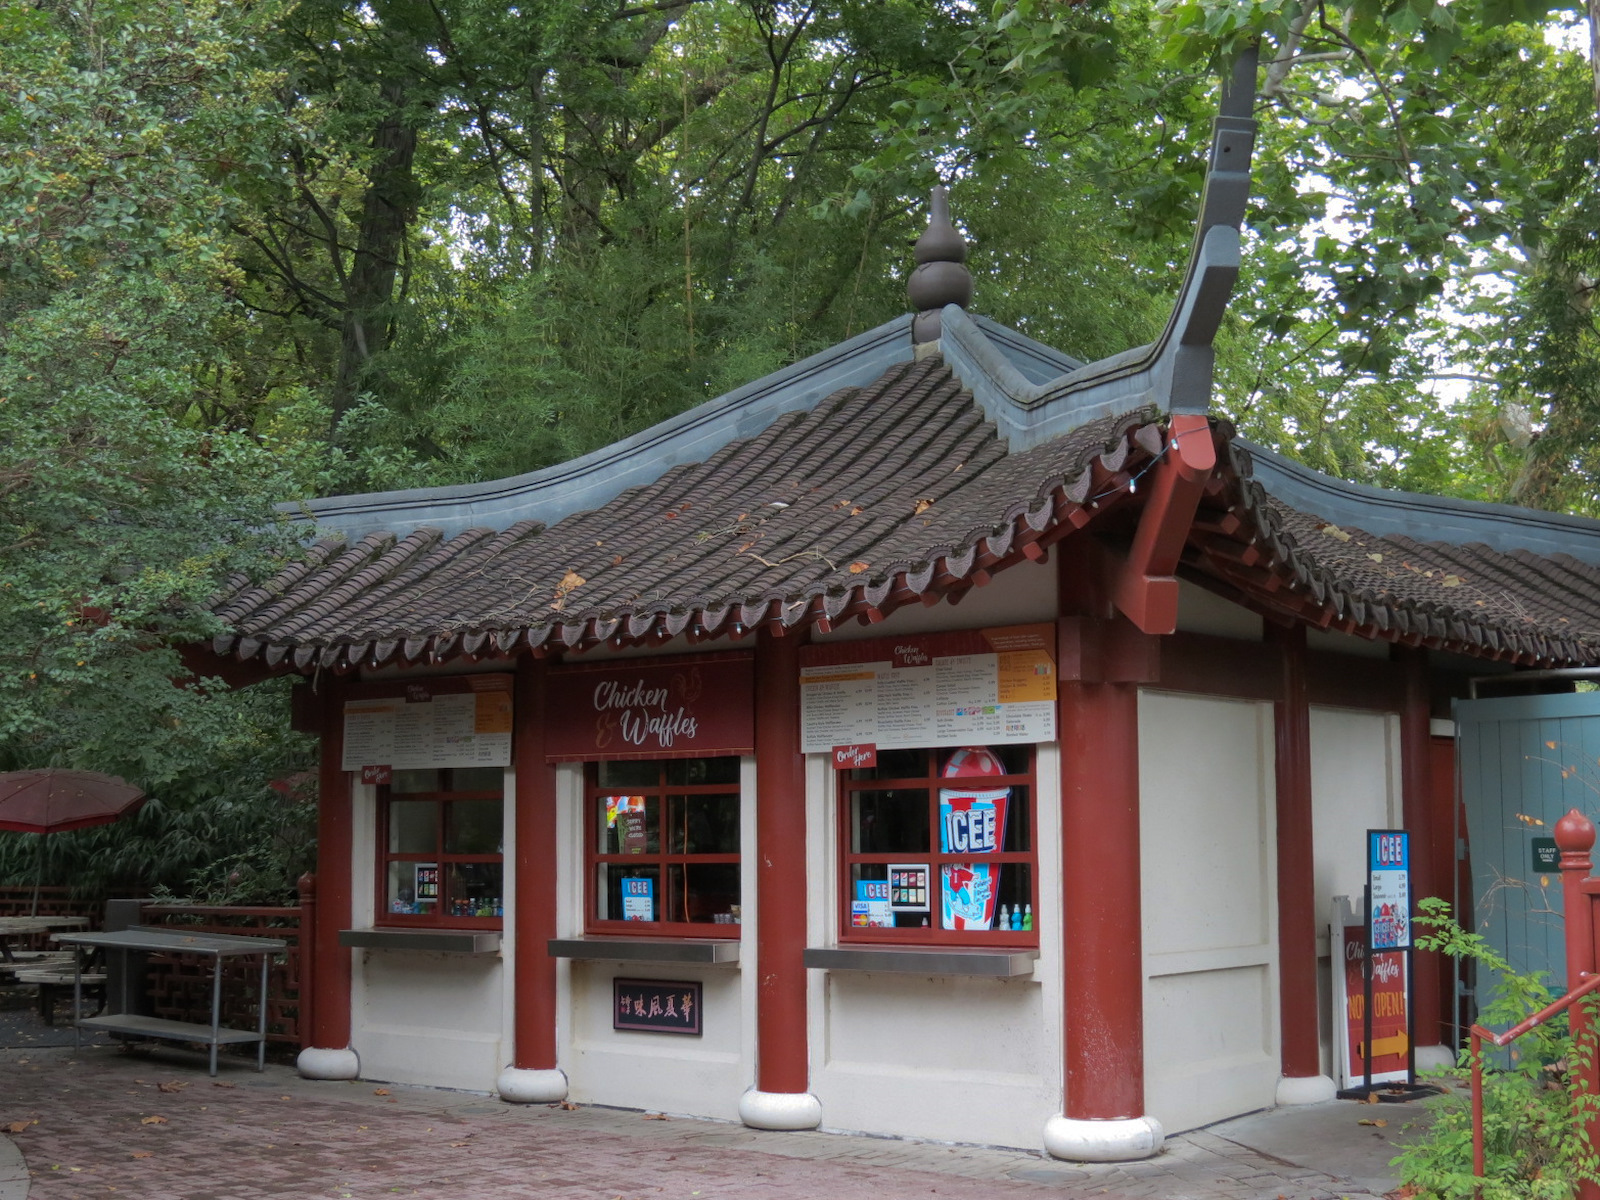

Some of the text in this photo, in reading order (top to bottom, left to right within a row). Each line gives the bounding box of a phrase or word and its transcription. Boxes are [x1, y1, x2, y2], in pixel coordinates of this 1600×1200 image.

[594, 679, 669, 712] Chicken
[620, 706, 698, 748] Waffles
[837, 746, 859, 762] Order
[854, 752, 872, 766] Here
[945, 808, 997, 852] ICEE
[1376, 835, 1403, 866] ICEE
[627, 881, 648, 895] ICEE
[863, 883, 889, 899] ICEE
[1348, 991, 1403, 1020] NO OPEN!
